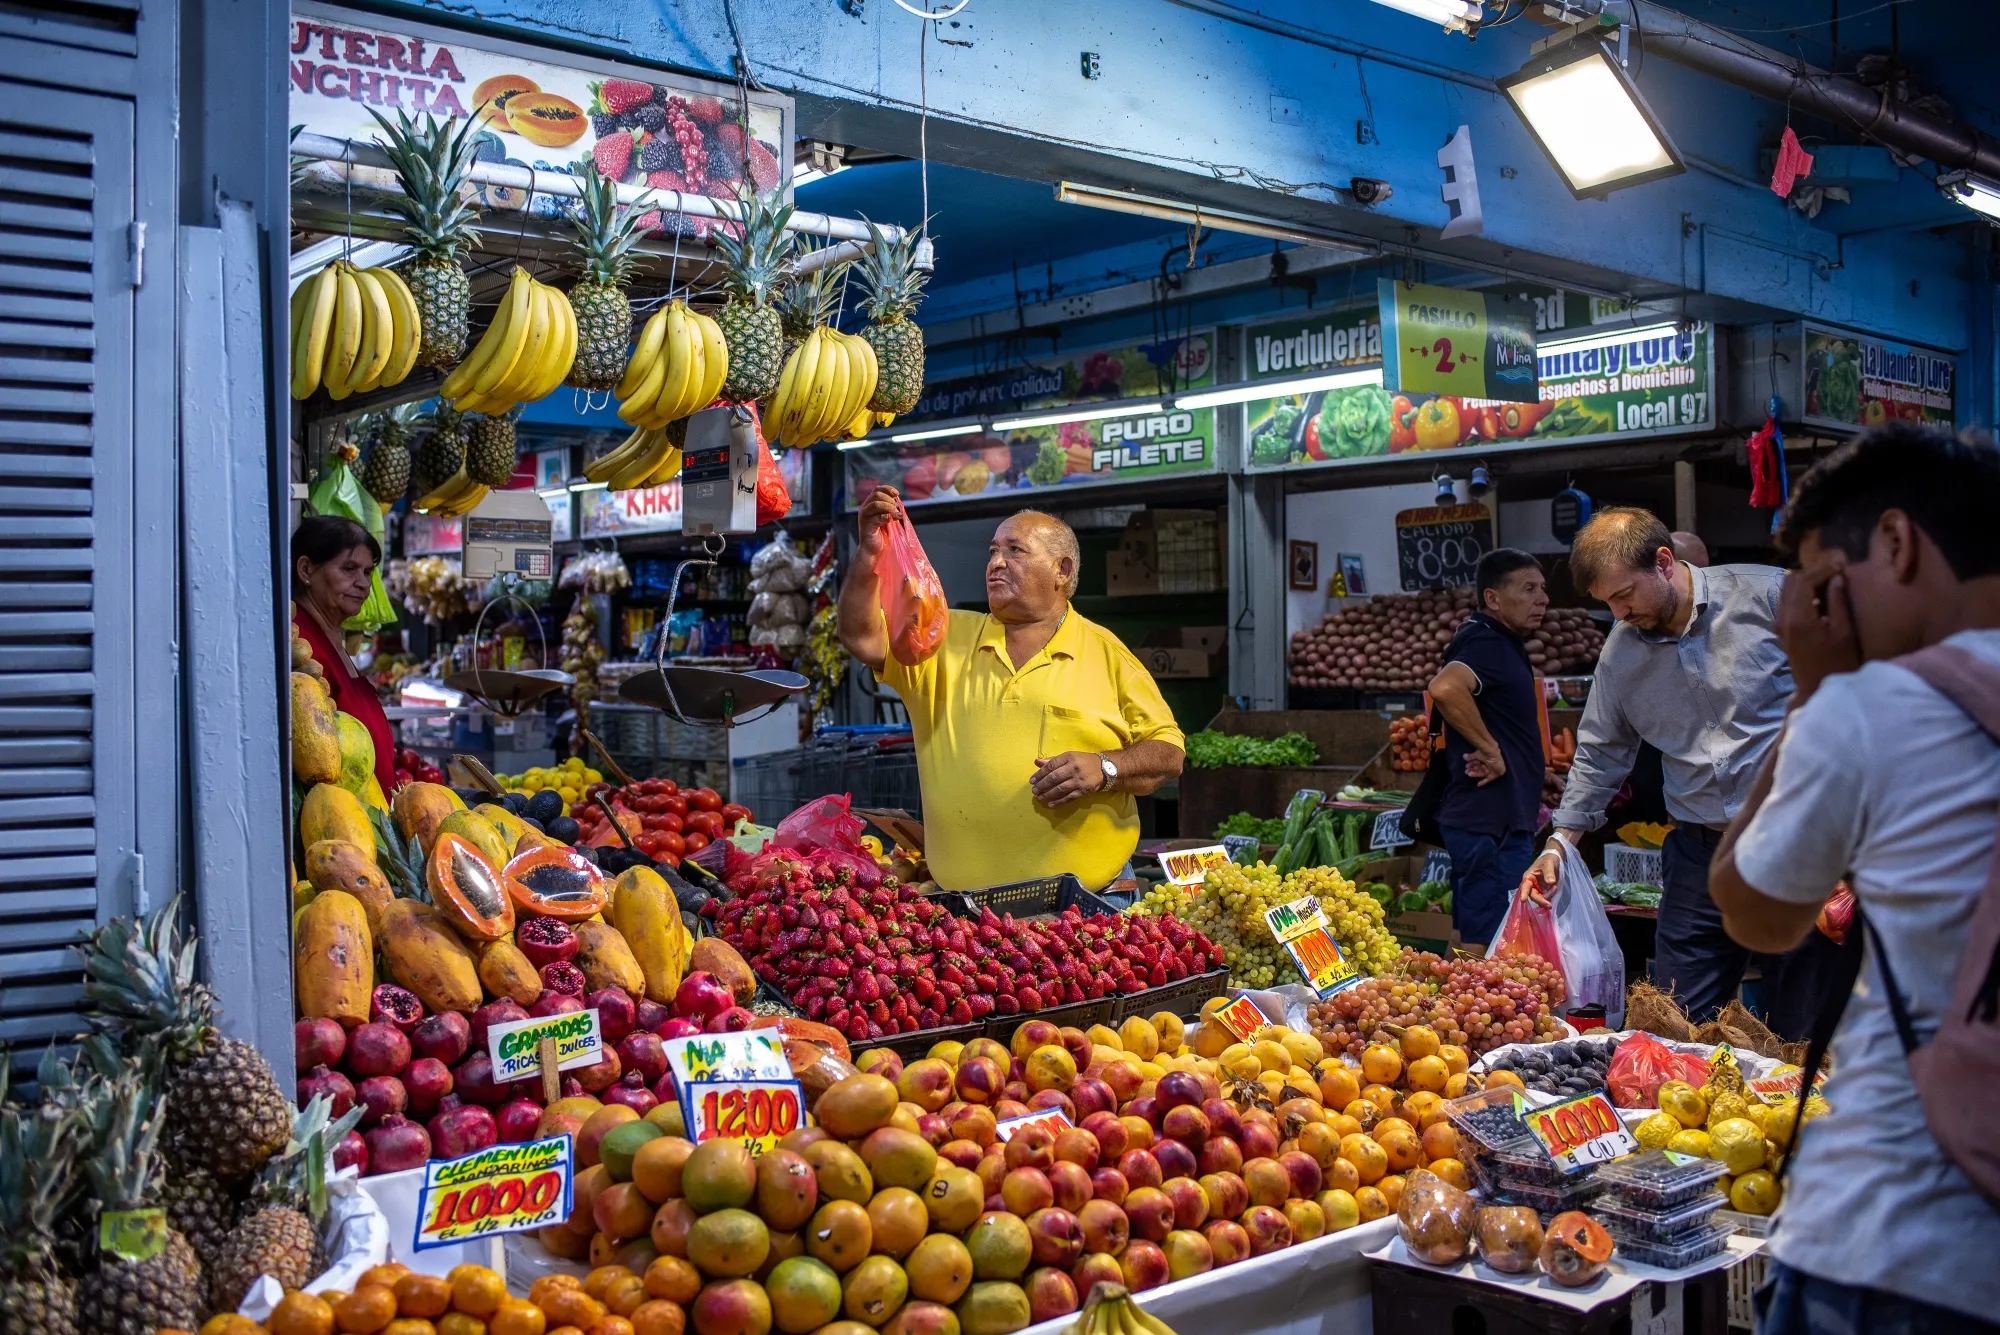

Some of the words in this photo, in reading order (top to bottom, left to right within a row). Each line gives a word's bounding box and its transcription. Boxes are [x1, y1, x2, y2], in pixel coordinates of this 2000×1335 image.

[1409, 304, 1477, 329] PASILLO
[1255, 320, 1381, 372] Verduleria
[1433, 338, 1455, 373] 2
[1011, 369, 1062, 398] calidad
[1538, 378, 1606, 401] espachos
[1610, 378, 1619, 393] a
[1621, 366, 1696, 391] Domicilio
[1102, 412, 1193, 443] PURO
[1617, 395, 1675, 431] Local
[1681, 392, 1707, 425] 97
[1093, 438, 1204, 471] FILETE
[1400, 523, 1475, 540] CALIDAD
[1417, 536, 1482, 580] 800
[1442, 572, 1477, 590] KIL
[1166, 853, 1204, 880] UVA
[1268, 905, 1299, 932] UVA
[1292, 928, 1340, 981] 1000
[498, 1013, 593, 1060] GRANADAS
[1223, 999, 1265, 1041] 600
[698, 1089, 799, 1140] 1200
[1538, 1096, 1619, 1157] 1000
[434, 1139, 566, 1182] CLEMENTINA
[421, 1171, 562, 1234] 1000
[438, 1228, 461, 1241] EL
[473, 1218, 499, 1234] 1/2
[509, 1211, 557, 1229] KILO
